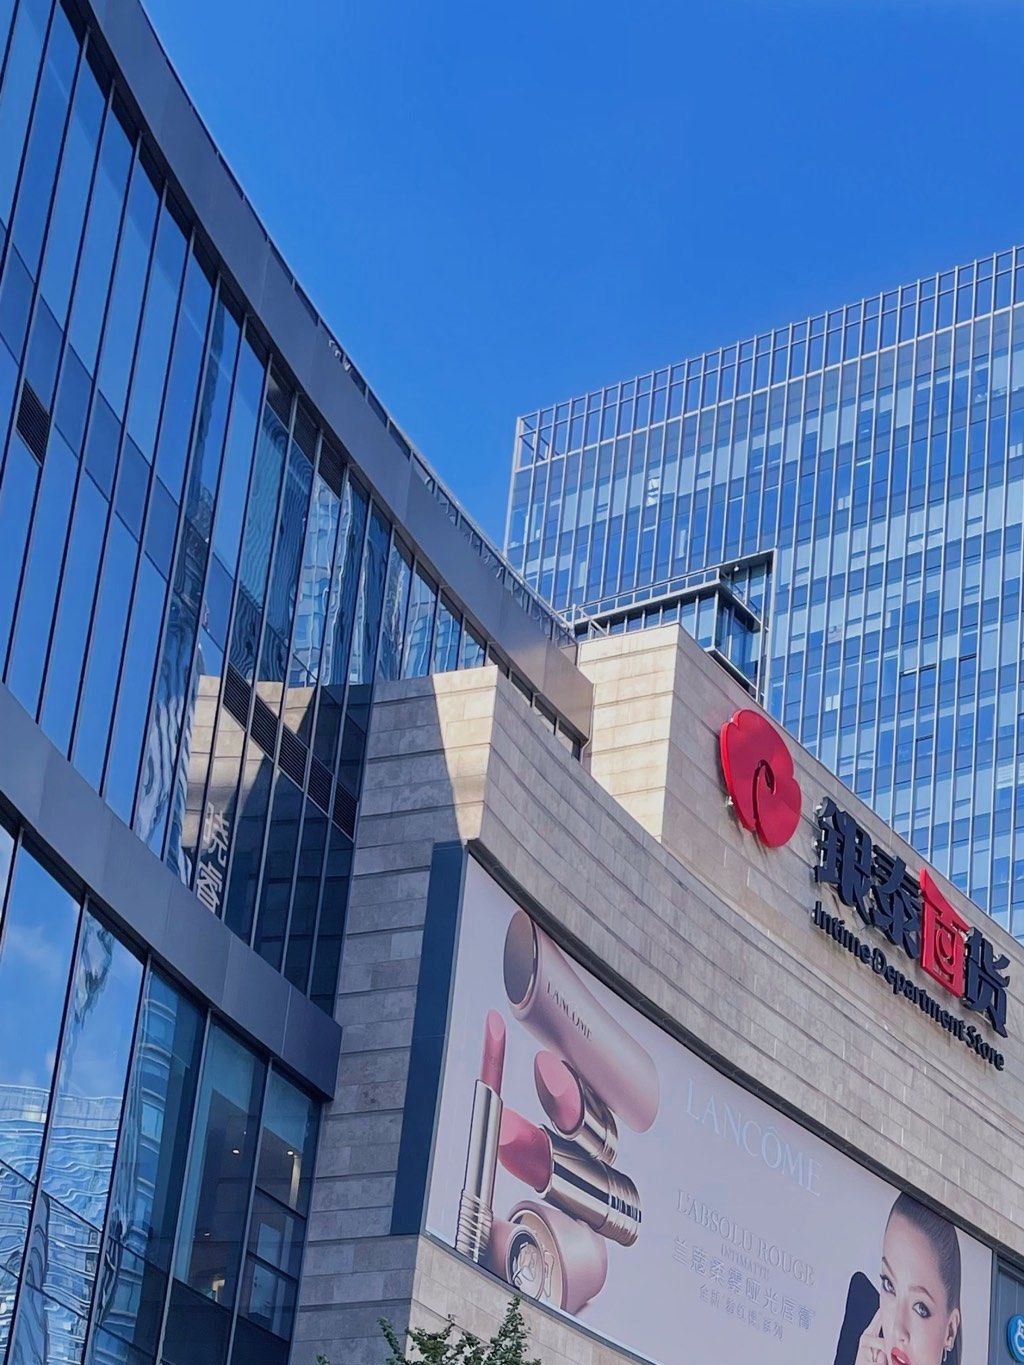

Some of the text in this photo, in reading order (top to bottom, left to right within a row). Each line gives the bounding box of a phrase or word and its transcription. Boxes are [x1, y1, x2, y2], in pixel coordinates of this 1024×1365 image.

[811, 900, 1005, 1072] Intime Department Store
[813, 796, 1010, 1038] 银泰百货
[685, 1076, 824, 1198] LANCÔME
[676, 1189, 817, 1287] L'ABSOLU ROUGE
